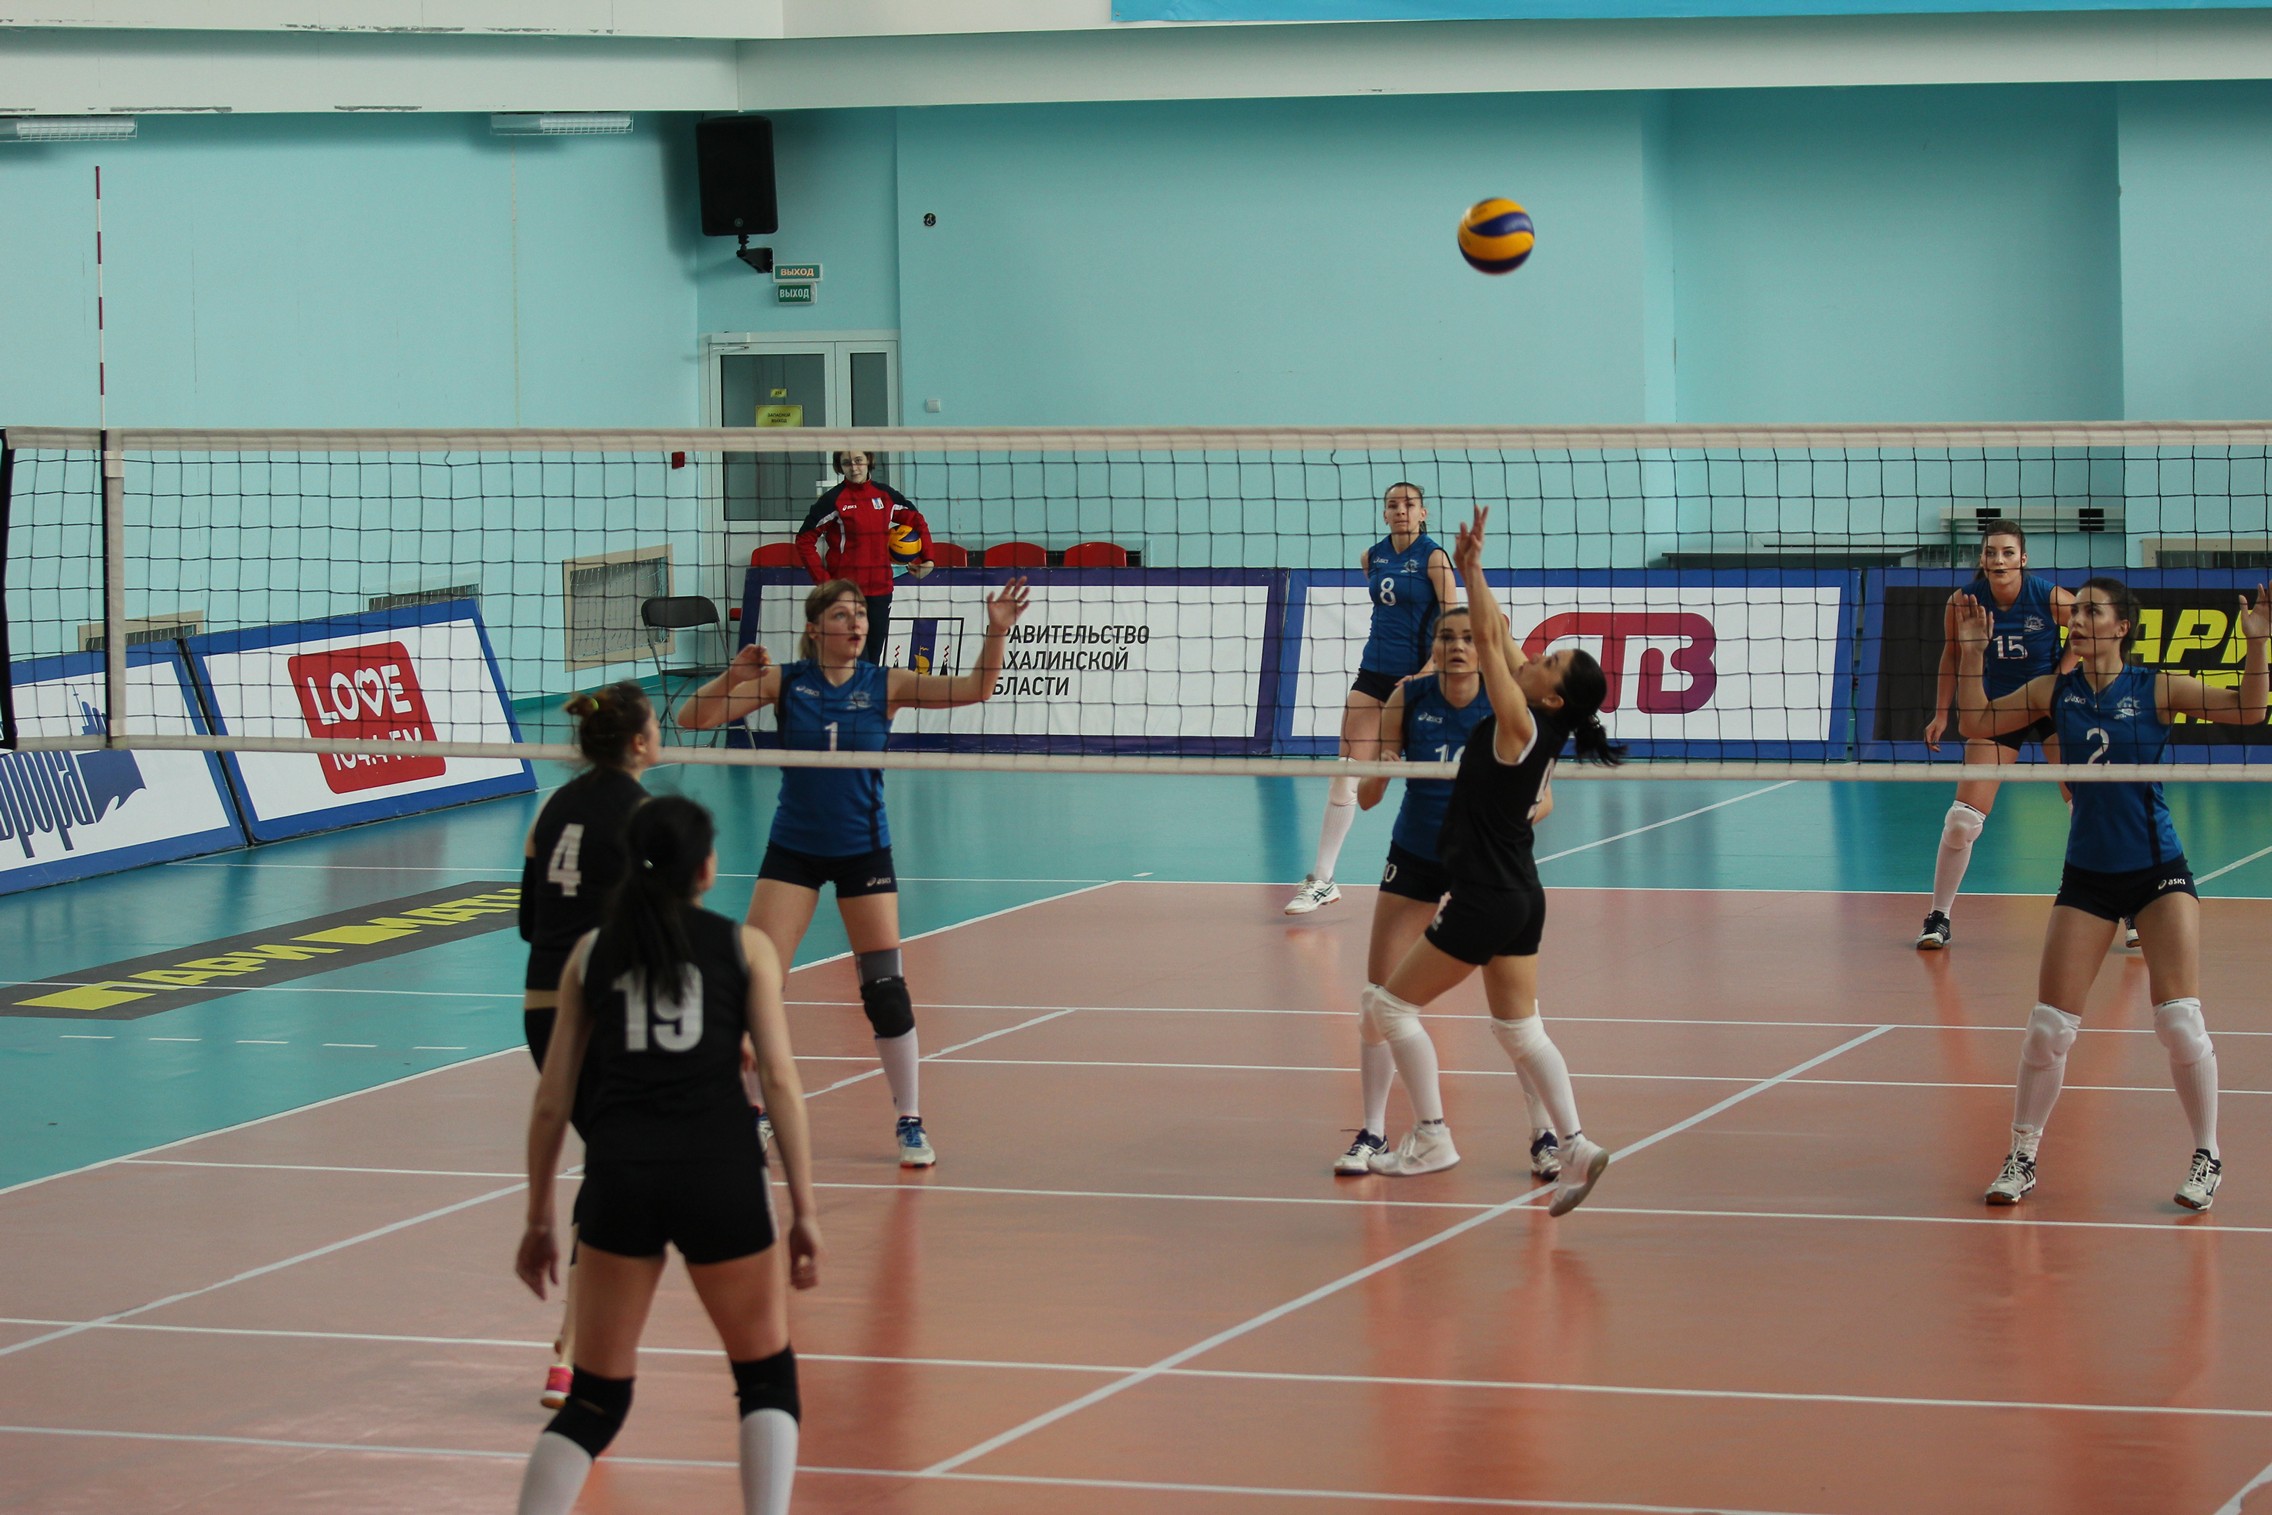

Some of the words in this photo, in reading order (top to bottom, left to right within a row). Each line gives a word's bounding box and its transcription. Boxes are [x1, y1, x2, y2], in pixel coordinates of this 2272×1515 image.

[780, 268, 814, 277] ВЫХОД
[779, 288, 810, 300] ВЫХОД
[1380, 577, 1397, 607] 8
[987, 625, 1149, 644] АВИТЕЛЬСТВО
[1993, 635, 2028, 659] 15
[1002, 647, 1128, 670] ХАЛИНСКОЙ
[307, 664, 412, 725] LOVE
[992, 677, 1069, 696] БЛАСТИ
[825, 721, 838, 752] 1
[2086, 727, 2110, 765] 2
[547, 823, 584, 896] 4
[612, 961, 704, 1053] 19
